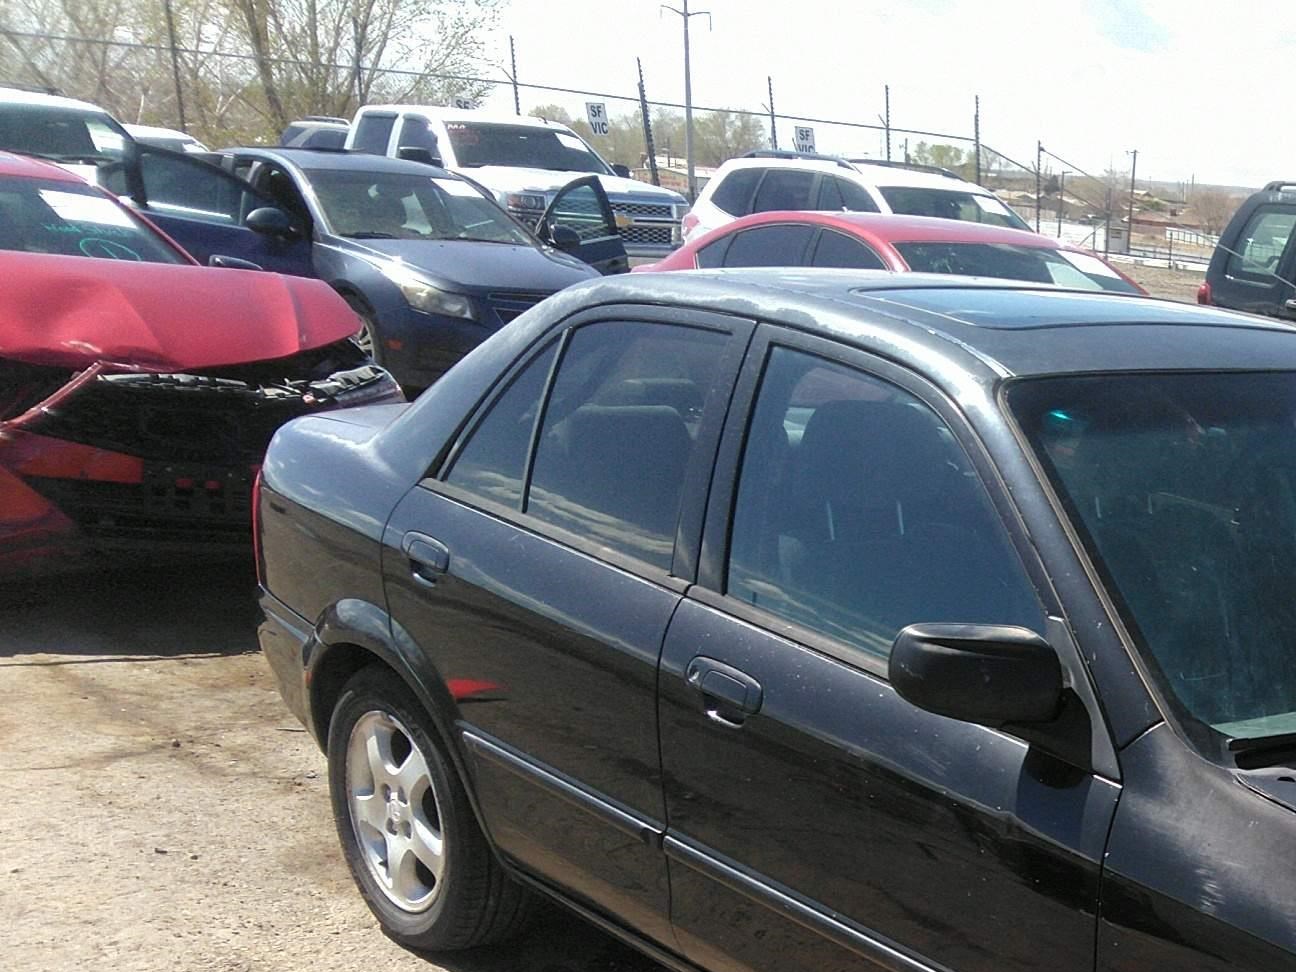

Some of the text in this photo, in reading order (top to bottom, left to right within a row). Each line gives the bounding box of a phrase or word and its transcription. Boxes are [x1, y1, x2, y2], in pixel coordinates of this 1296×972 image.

[590, 105, 602, 118] SF
[590, 121, 609, 134] VIC
[799, 129, 810, 141] SF
